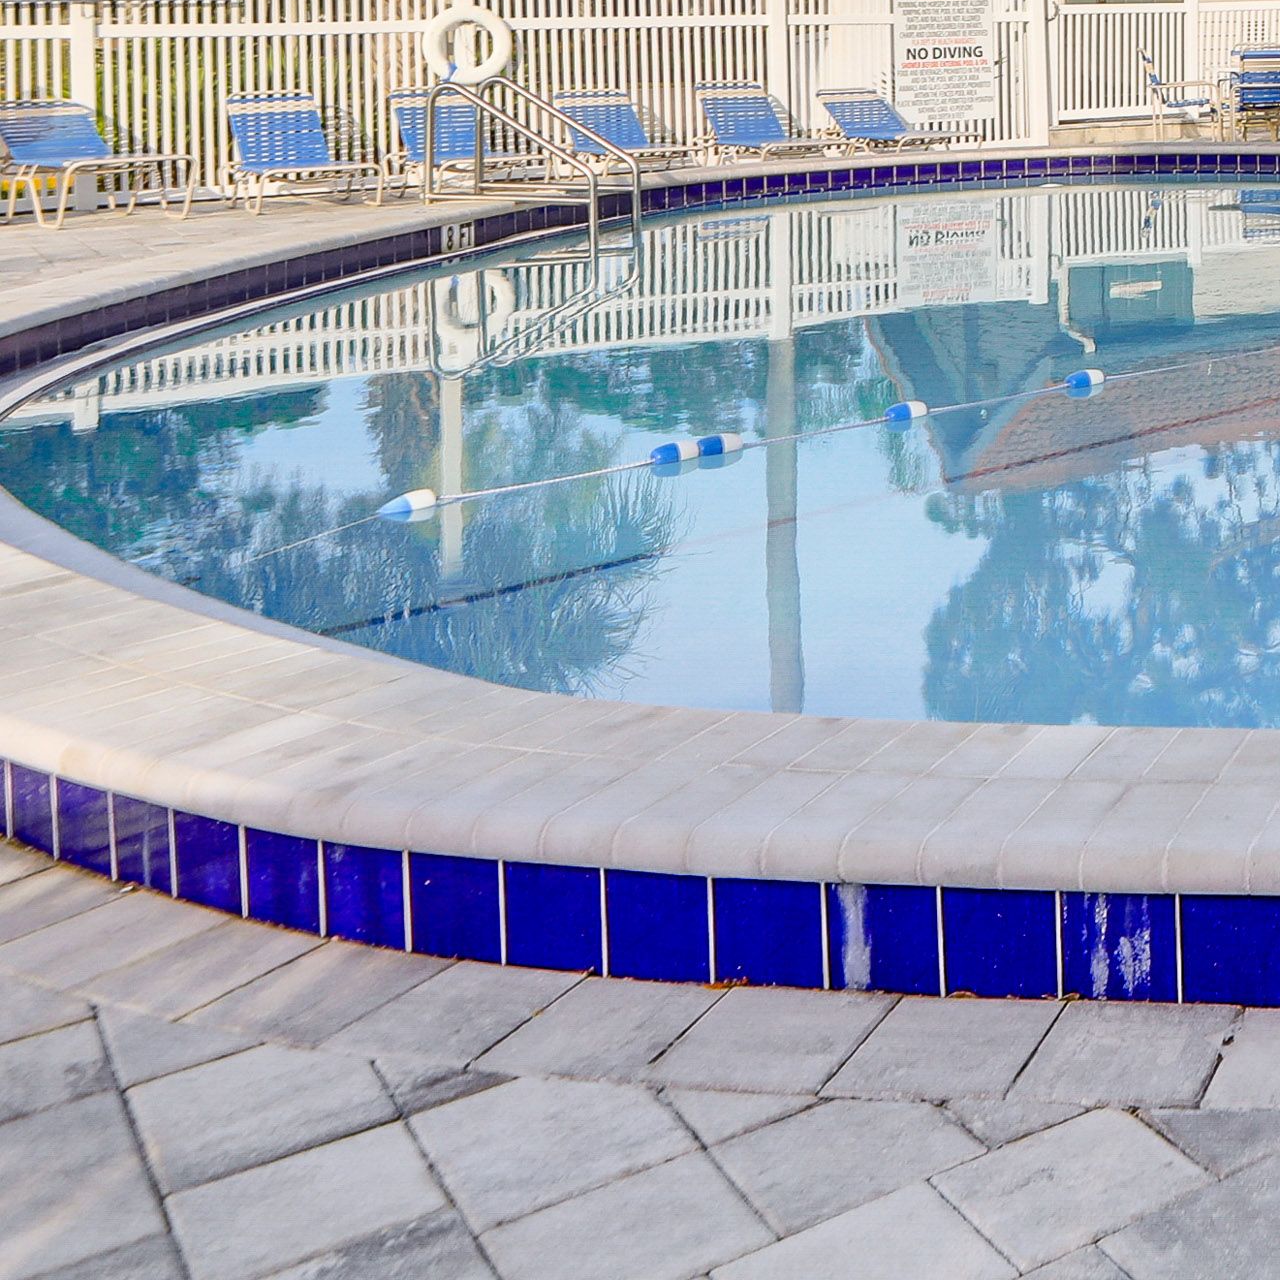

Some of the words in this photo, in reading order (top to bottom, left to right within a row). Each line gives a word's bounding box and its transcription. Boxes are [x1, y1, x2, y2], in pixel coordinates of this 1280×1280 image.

[906, 47, 928, 60] NO
[932, 45, 984, 60] DIVING
[446, 225, 455, 251] 8
[460, 221, 473, 249] FT
